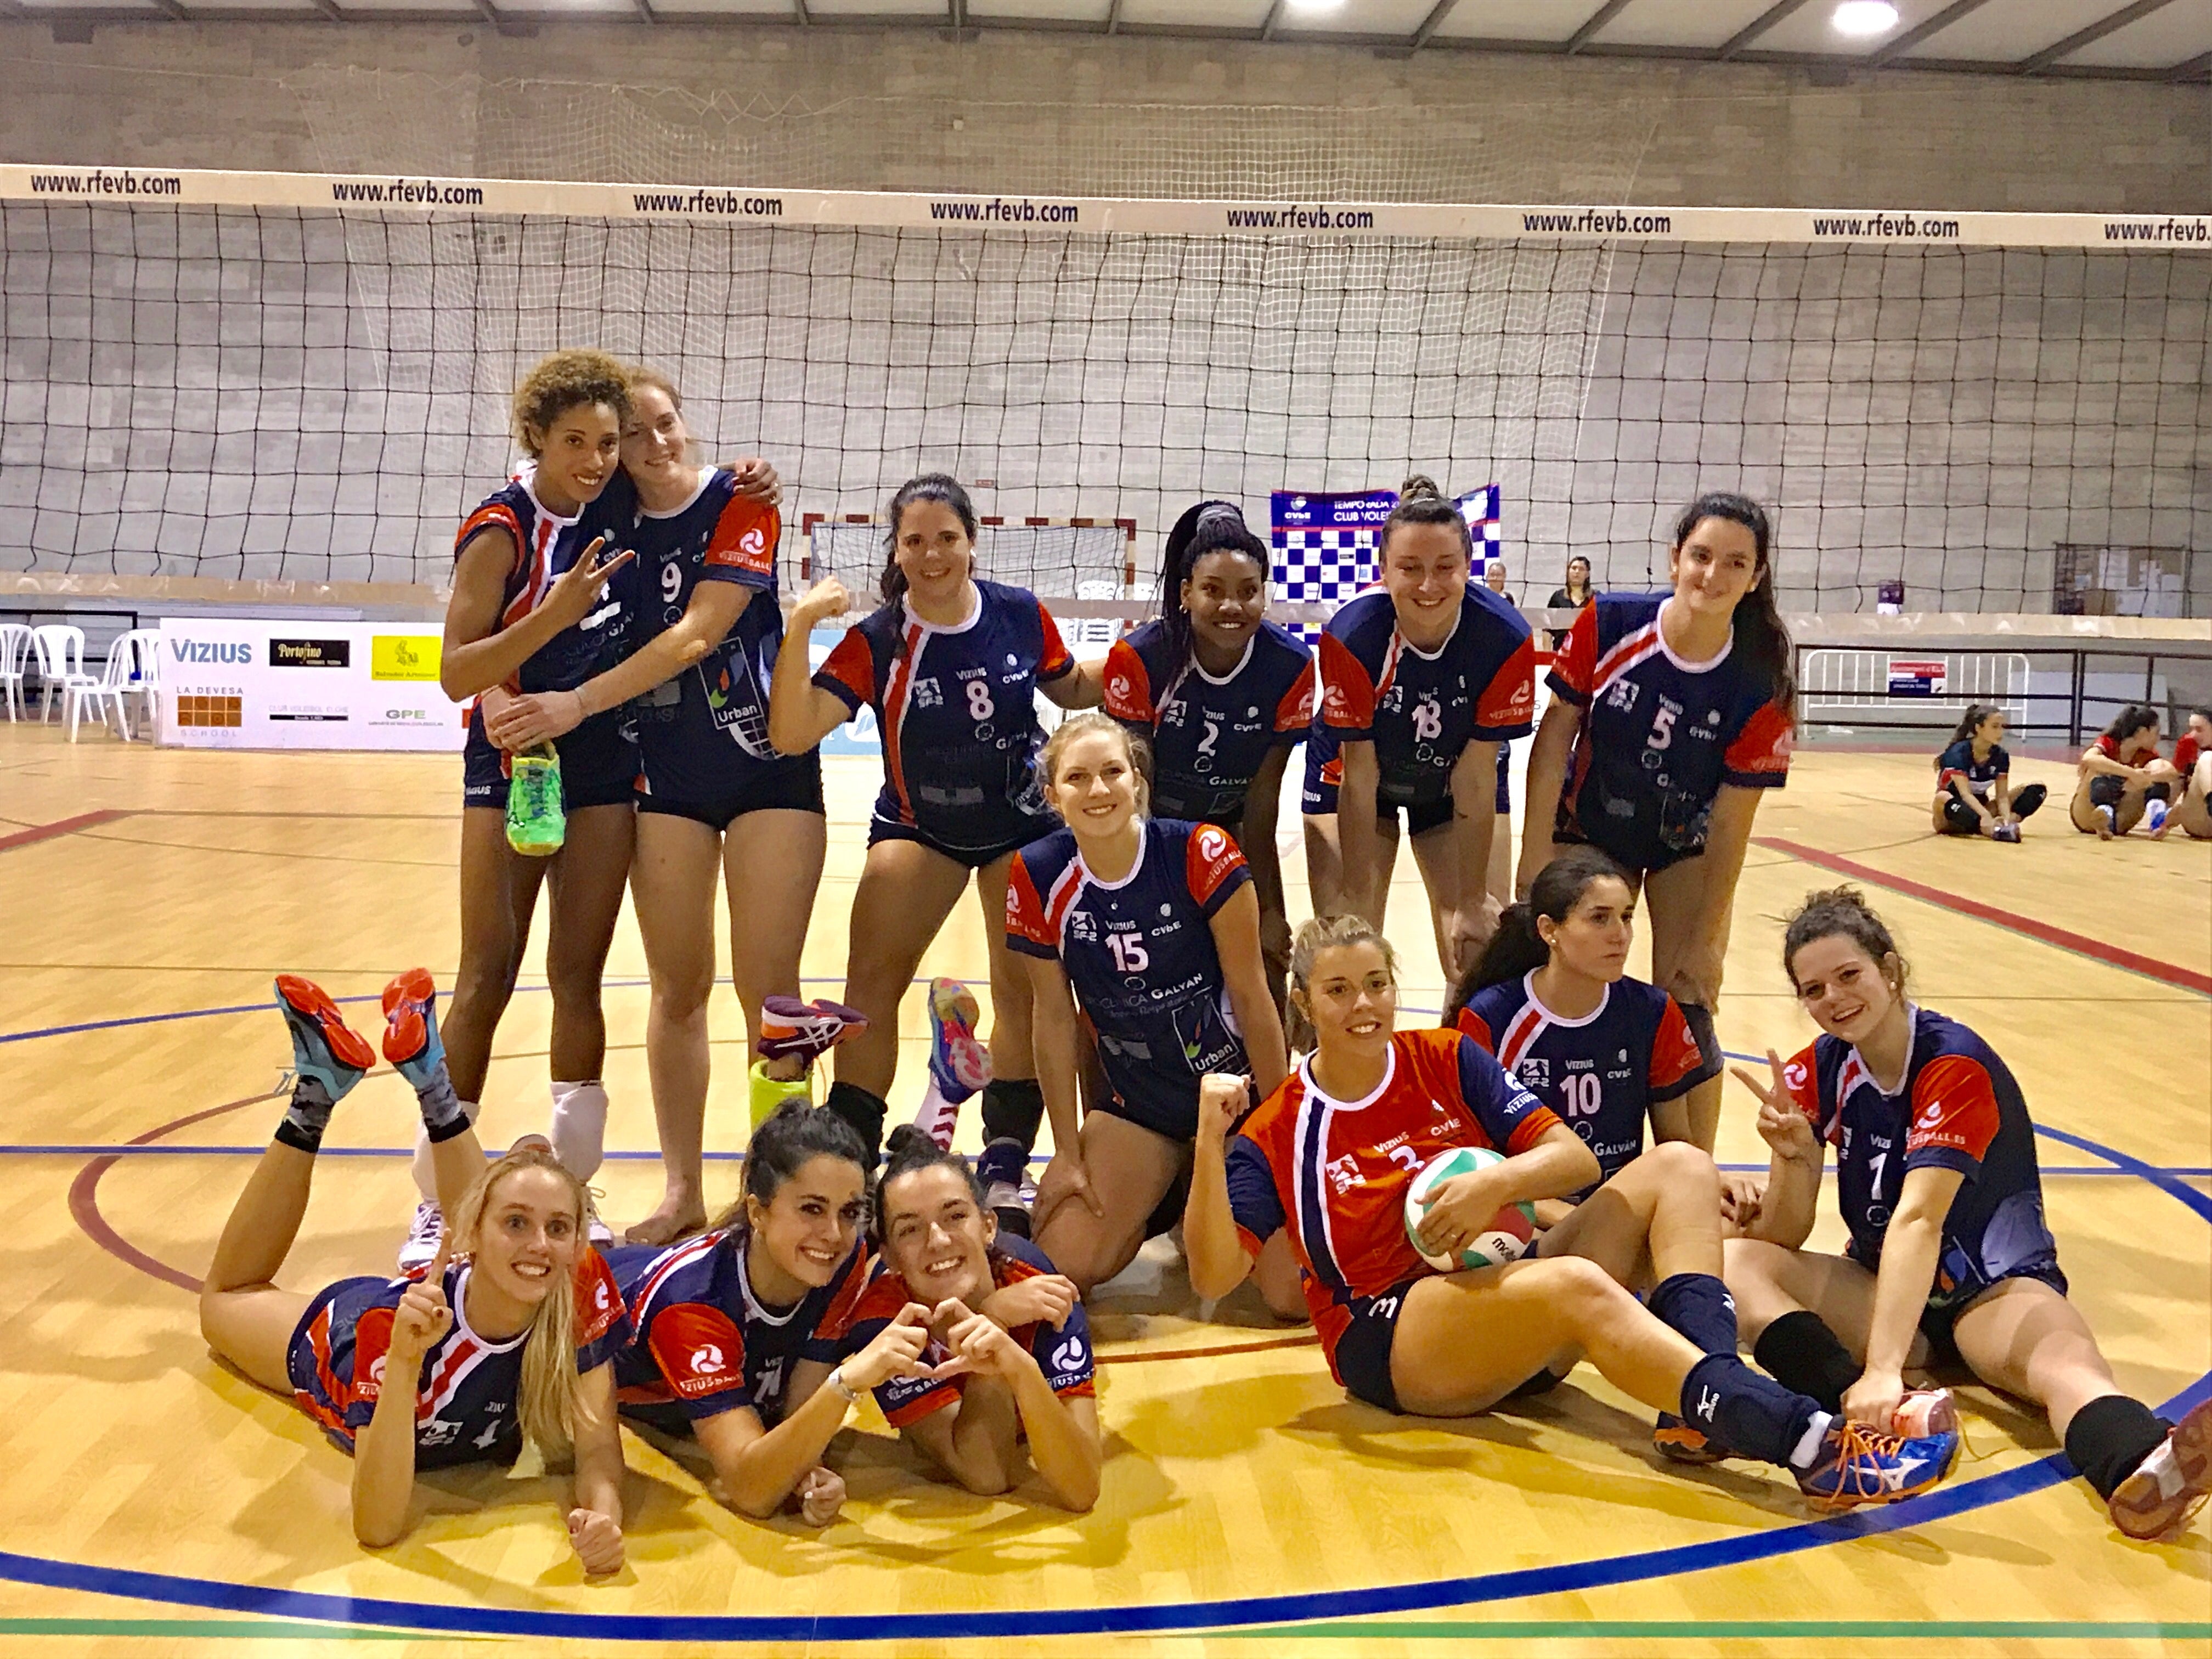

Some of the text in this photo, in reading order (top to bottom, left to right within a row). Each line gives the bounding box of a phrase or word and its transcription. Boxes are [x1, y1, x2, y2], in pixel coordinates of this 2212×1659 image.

[31, 171, 180, 194] www.rfevb.com
[332, 179, 483, 205] www.rfevb.com
[633, 189, 782, 216] www.rfevb.com
[930, 198, 1078, 223] www.rfevb.com
[1227, 205, 1373, 229] www.rfevb.com
[1522, 209, 1671, 233] www.rfevb.com
[1813, 213, 1959, 238] www.rfevb.com
[1333, 511, 1359, 521] CLUB
[661, 562, 682, 603] 9
[170, 639, 252, 663] VIZIUS
[278, 642, 321, 661] Portofino
[197, 686, 244, 695] DEVESA
[966, 680, 995, 721] 8
[386, 709, 426, 719] GPE
[718, 704, 758, 723] Urban
[1412, 699, 1442, 743] 18
[1197, 719, 1219, 757] 2
[1647, 707, 1677, 750] 5
[1209, 776, 1252, 786] GALVA
[1105, 919, 1137, 931] VIZIUS
[1104, 932, 1149, 972] 15
[1195, 1044, 1233, 1070] Urban
[1565, 1059, 1594, 1070] VIZIUS
[1559, 1073, 1602, 1117] 10
[1373, 1131, 1410, 1153] VIZIUS
